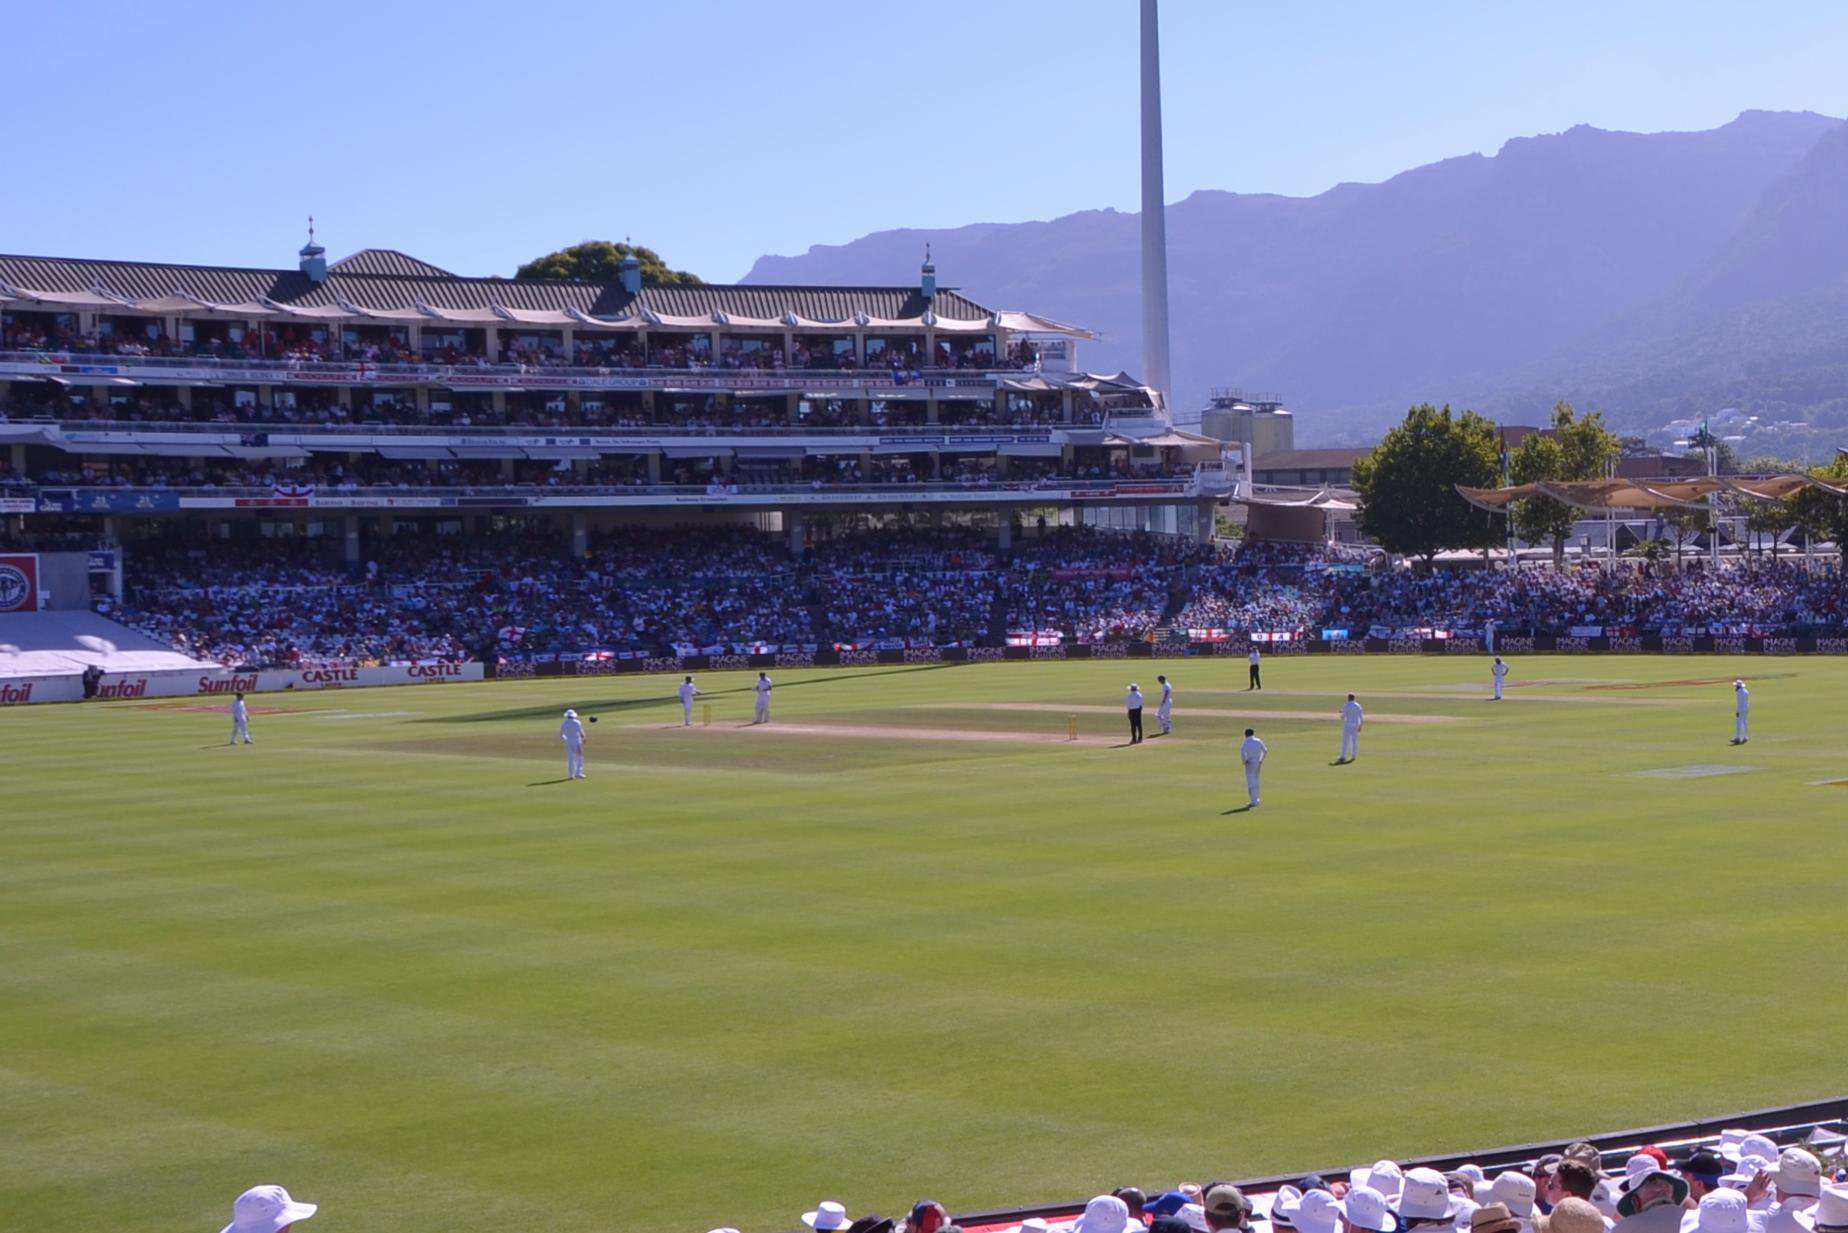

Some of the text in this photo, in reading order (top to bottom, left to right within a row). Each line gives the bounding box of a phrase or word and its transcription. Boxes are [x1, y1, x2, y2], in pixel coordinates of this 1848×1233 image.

[303, 669, 358, 683] CASTLE
[408, 664, 462, 678] CASTLE
[0, 683, 32, 702] foil
[96, 679, 146, 698] unfoil
[198, 674, 258, 694] Sunfoil
